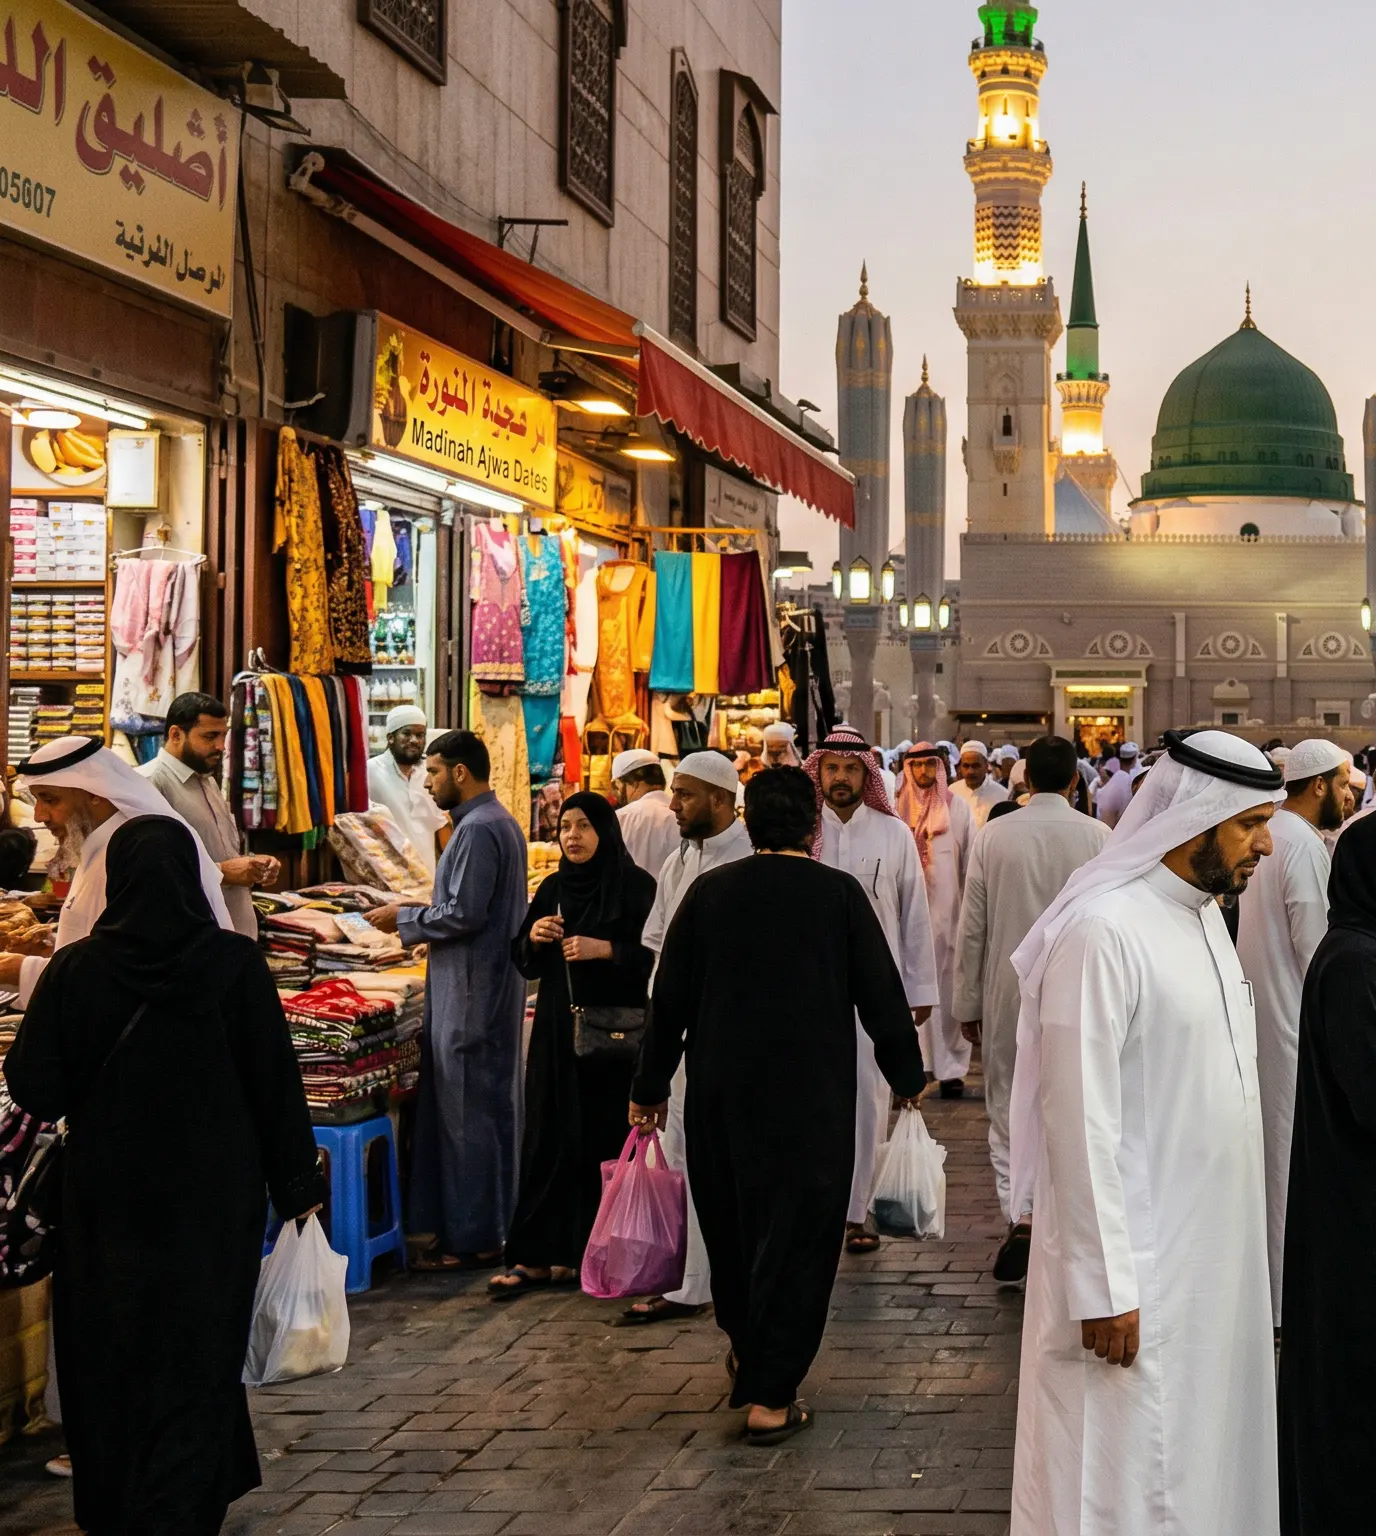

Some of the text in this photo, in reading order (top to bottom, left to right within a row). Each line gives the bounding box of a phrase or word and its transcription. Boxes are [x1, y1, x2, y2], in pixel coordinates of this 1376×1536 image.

[411, 417, 548, 494] Madinah Ajwa Dates
